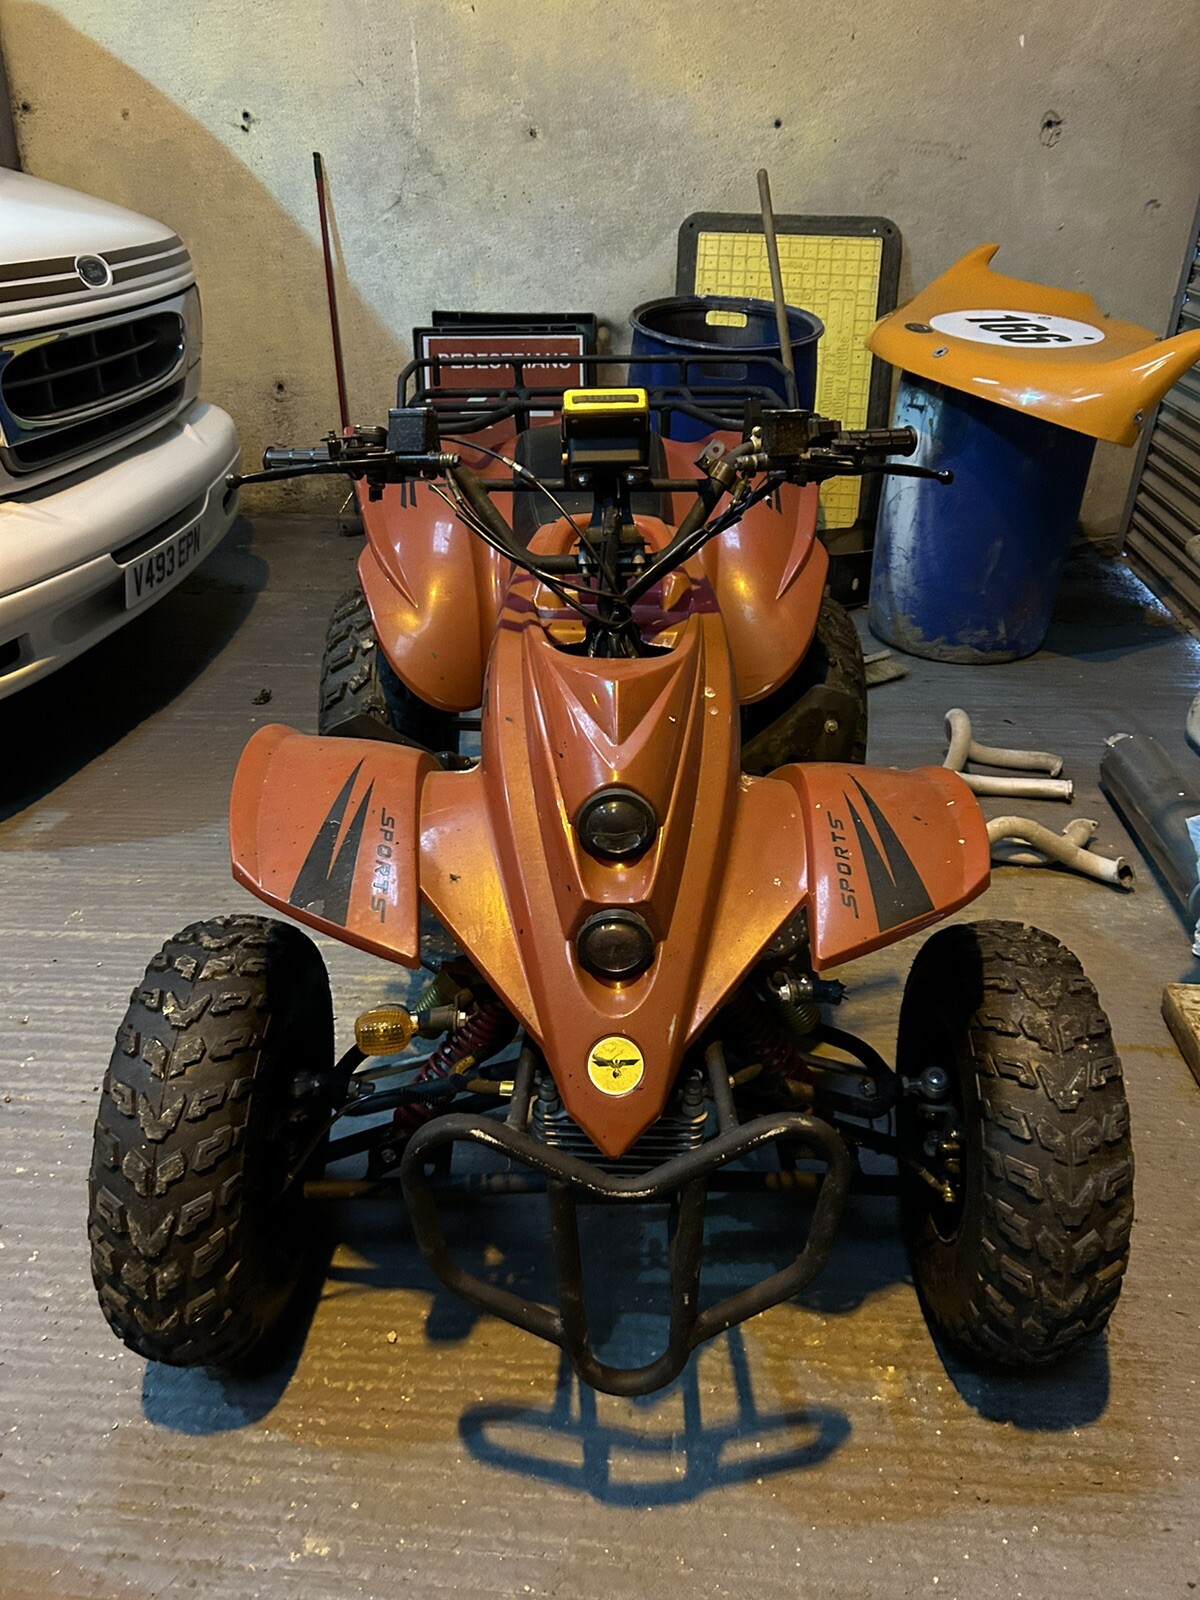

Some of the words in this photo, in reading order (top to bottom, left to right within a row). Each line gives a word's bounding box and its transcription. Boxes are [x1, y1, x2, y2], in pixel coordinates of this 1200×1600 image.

[966, 315, 1072, 343] 166
[134, 545, 175, 597] V493
[179, 523, 201, 568] EPN
[370, 807, 395, 924] SPORTS
[827, 811, 859, 919] SPORTS
